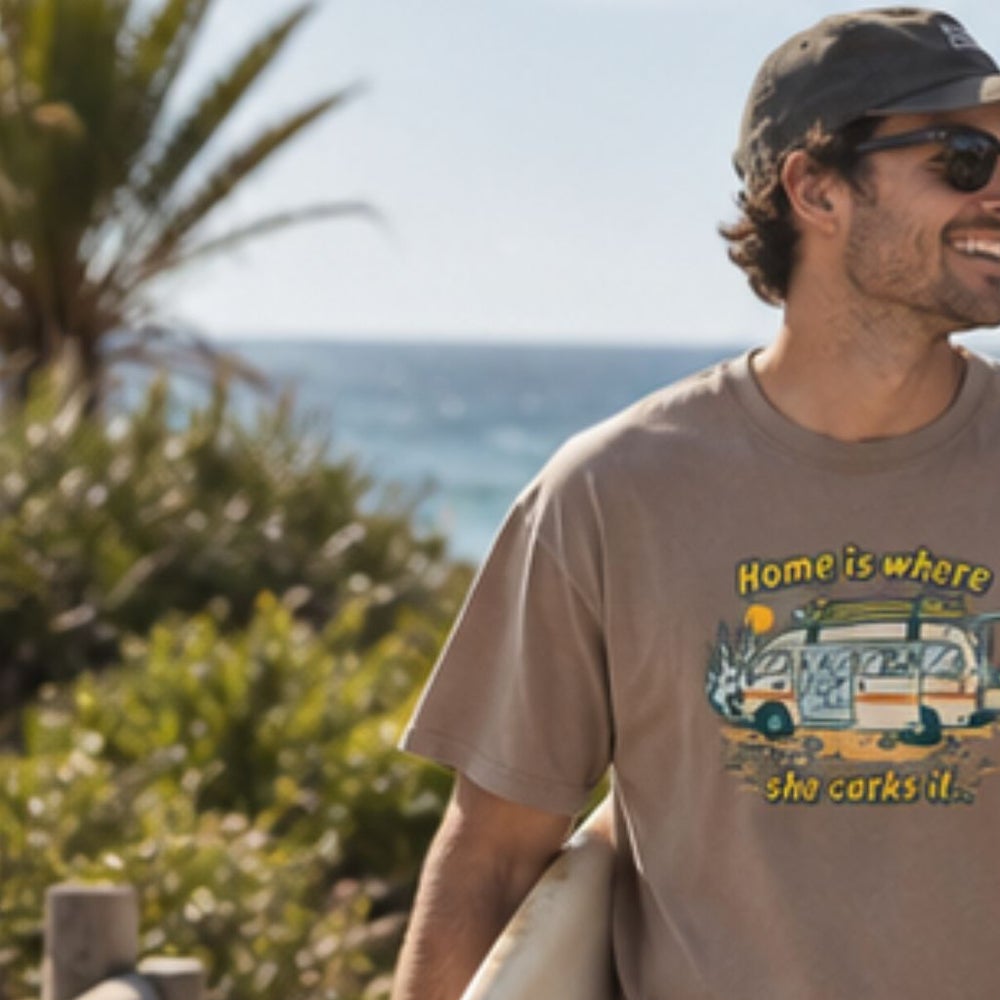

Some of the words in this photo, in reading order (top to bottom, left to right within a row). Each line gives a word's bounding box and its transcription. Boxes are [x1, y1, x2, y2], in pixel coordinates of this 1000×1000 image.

[738, 552, 836, 596] Home
[844, 544, 876, 580] is
[882, 547, 994, 593] where
